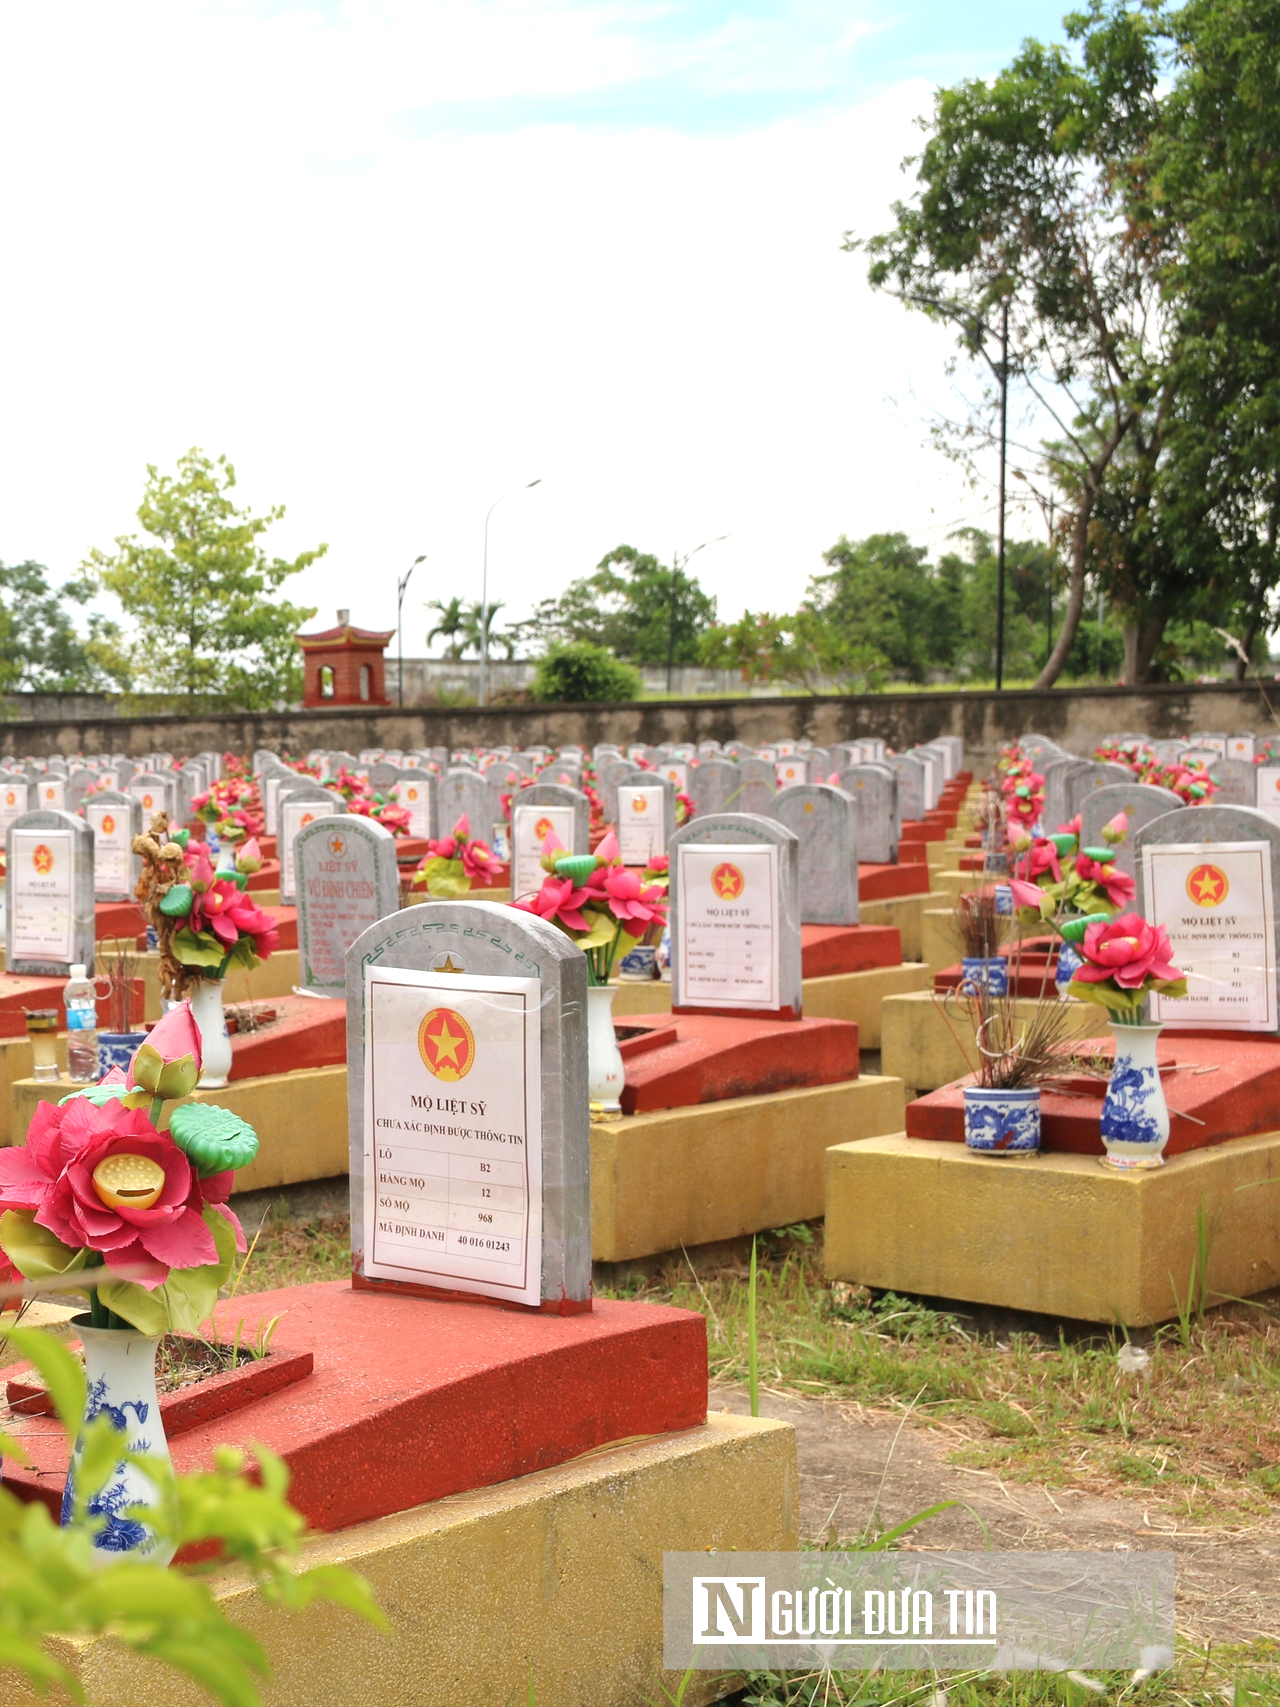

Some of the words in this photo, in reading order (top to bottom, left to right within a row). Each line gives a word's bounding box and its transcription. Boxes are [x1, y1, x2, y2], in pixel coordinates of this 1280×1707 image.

[1200, 916, 1222, 927] LIỆT
[411, 1095, 433, 1112] MỘ
[436, 1098, 467, 1115] LIỆT
[470, 1100, 487, 1116] SỸ
[376, 1118, 402, 1130] CHƯA
[404, 1120, 422, 1132] XÁC
[424, 1123, 446, 1135] ĐỊNH
[447, 1126, 473, 1139] ĐƯỢC
[474, 1129, 506, 1143] THÔNG
[507, 1134, 523, 1145] TIN
[379, 1148, 392, 1159] LÔ
[480, 1162, 491, 1173] B2
[379, 1172, 407, 1186] HÀNG
[409, 1178, 425, 1190] MỘ
[481, 1188, 491, 1198] 12
[379, 1196, 392, 1208] SỐ
[394, 1200, 410, 1213] MỘ
[478, 1213, 493, 1223] 968
[379, 1221, 393, 1233] MÃ
[395, 1225, 417, 1237] ĐỊNH
[419, 1229, 445, 1241] DANH
[457, 1235, 467, 1245] 40
[469, 1237, 484, 1248] 016
[486, 1239, 510, 1252] 01243
